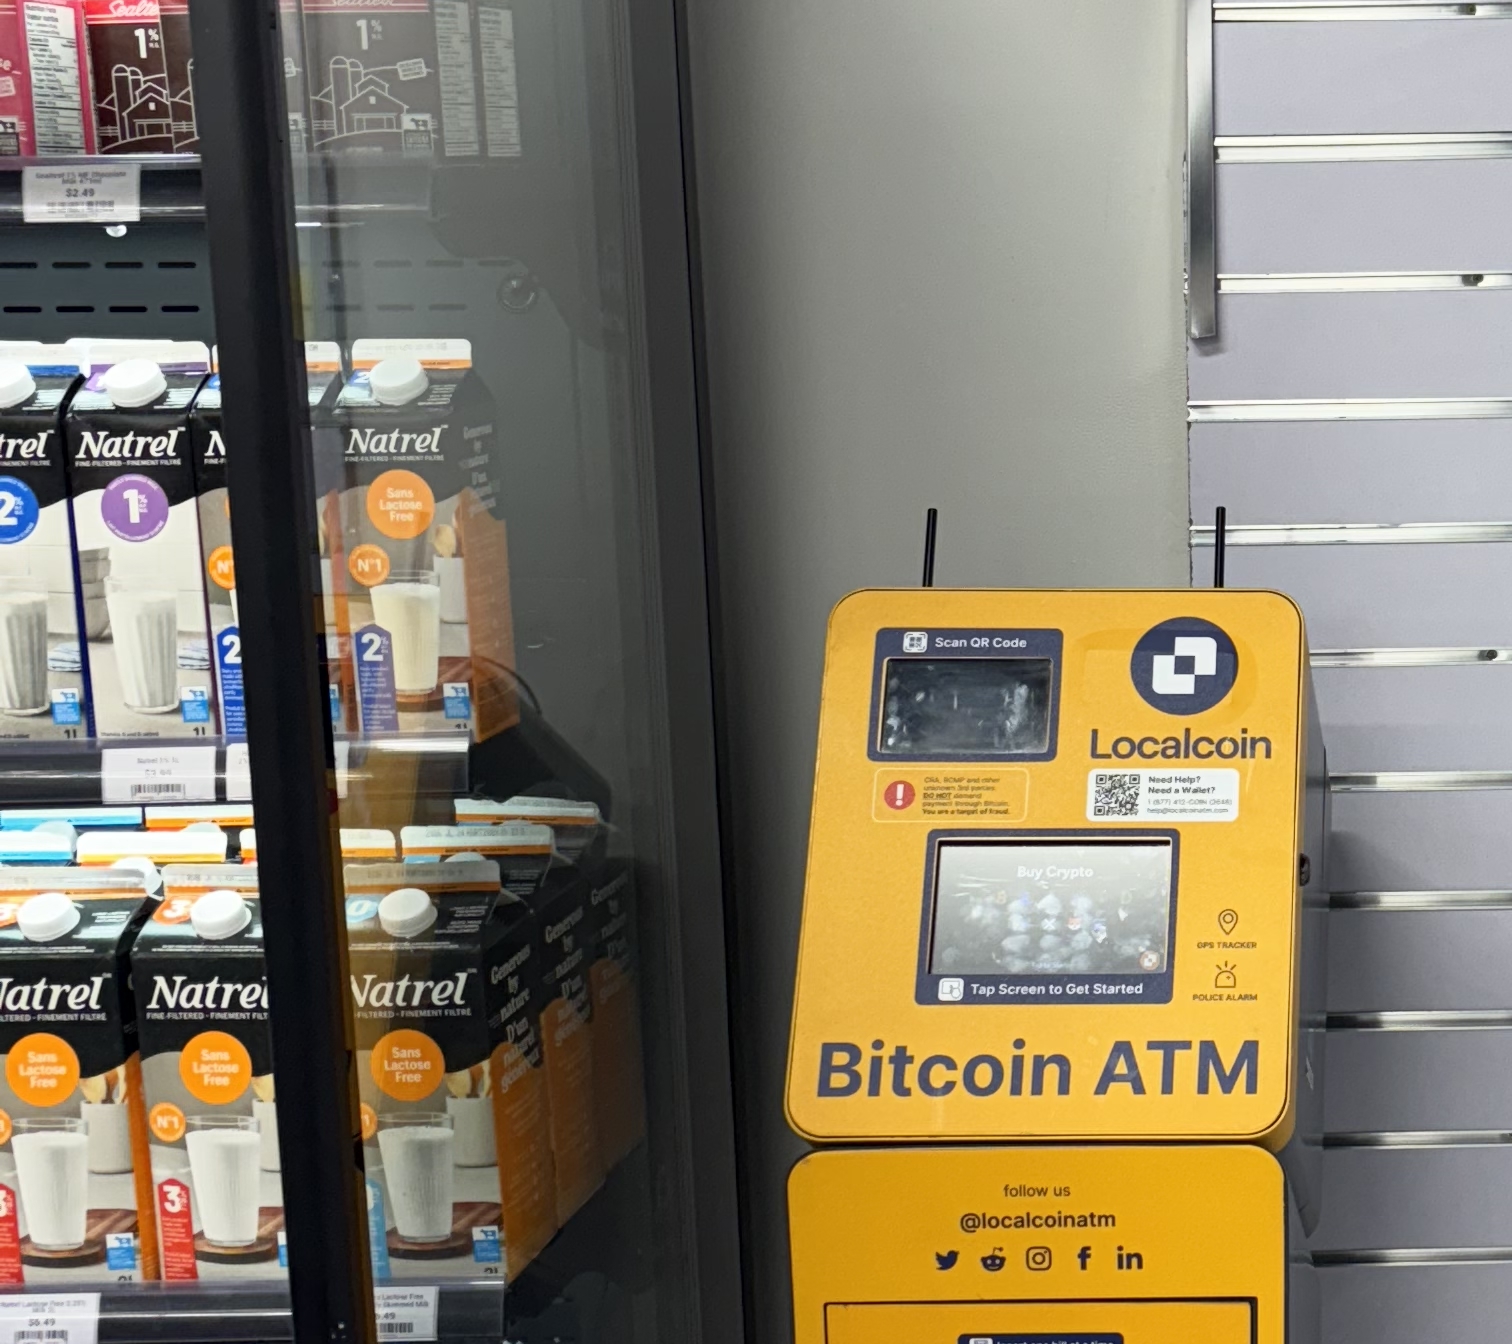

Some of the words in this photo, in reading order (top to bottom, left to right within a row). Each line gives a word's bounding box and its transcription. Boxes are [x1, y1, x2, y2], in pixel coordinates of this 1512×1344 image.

[109, 0, 159, 17] Sealte
[65, 188, 95, 197] $2.49
[0, 431, 47, 458] trel
[75, 429, 179, 459] Natrel
[345, 427, 442, 454] Natrel
[386, 487, 414, 498] Sans
[379, 499, 423, 511] Lactose
[390, 511, 414, 522] Free
[935, 637, 967, 648] Scan
[970, 637, 989, 648] QR
[993, 637, 1027, 648] Code
[1090, 727, 1272, 761] Localcoin
[1148, 776, 1172, 784] Need
[1174, 776, 1201, 785] Help?
[1182, 786, 1216, 794] Wallet?
[1017, 866, 1043, 880] Buy
[1046, 865, 1094, 880] Crypto
[1197, 941, 1215, 949] GPS
[1217, 941, 1257, 949] TRACKER
[490, 944, 531, 985] Generous
[971, 983, 996, 996] Tap
[998, 983, 1046, 995] Screen
[1049, 983, 1063, 994] to
[1065, 983, 1090, 995] Get
[1093, 982, 1143, 995] Started
[1192, 993, 1224, 1001] POLICE
[1226, 993, 1258, 1001] ALARM
[500, 988, 531, 1023] nature
[37, 1013, 78, 1021] FINEMENT
[146, 1012, 204, 1021] FINE-FILTERED
[210, 1012, 251, 1020] FINEMENT
[401, 1009, 442, 1018] FINEMENT
[27, 1051, 57, 1064] Sans
[201, 1049, 230, 1062] Sans
[392, 1046, 421, 1059] Sans
[18, 1064, 67, 1076] Lactose
[192, 1062, 239, 1073] Lactose
[384, 1059, 431, 1071] Lactose
[817, 1038, 1072, 1099] Bitcoin
[1093, 1039, 1260, 1096] ATM
[30, 1076, 57, 1088] Free
[203, 1074, 230, 1086] Free
[395, 1071, 423, 1083] Free
[1003, 1184, 1048, 1197] follow
[1053, 1185, 1071, 1197] us
[960, 1210, 1116, 1233] @localcoinatm
